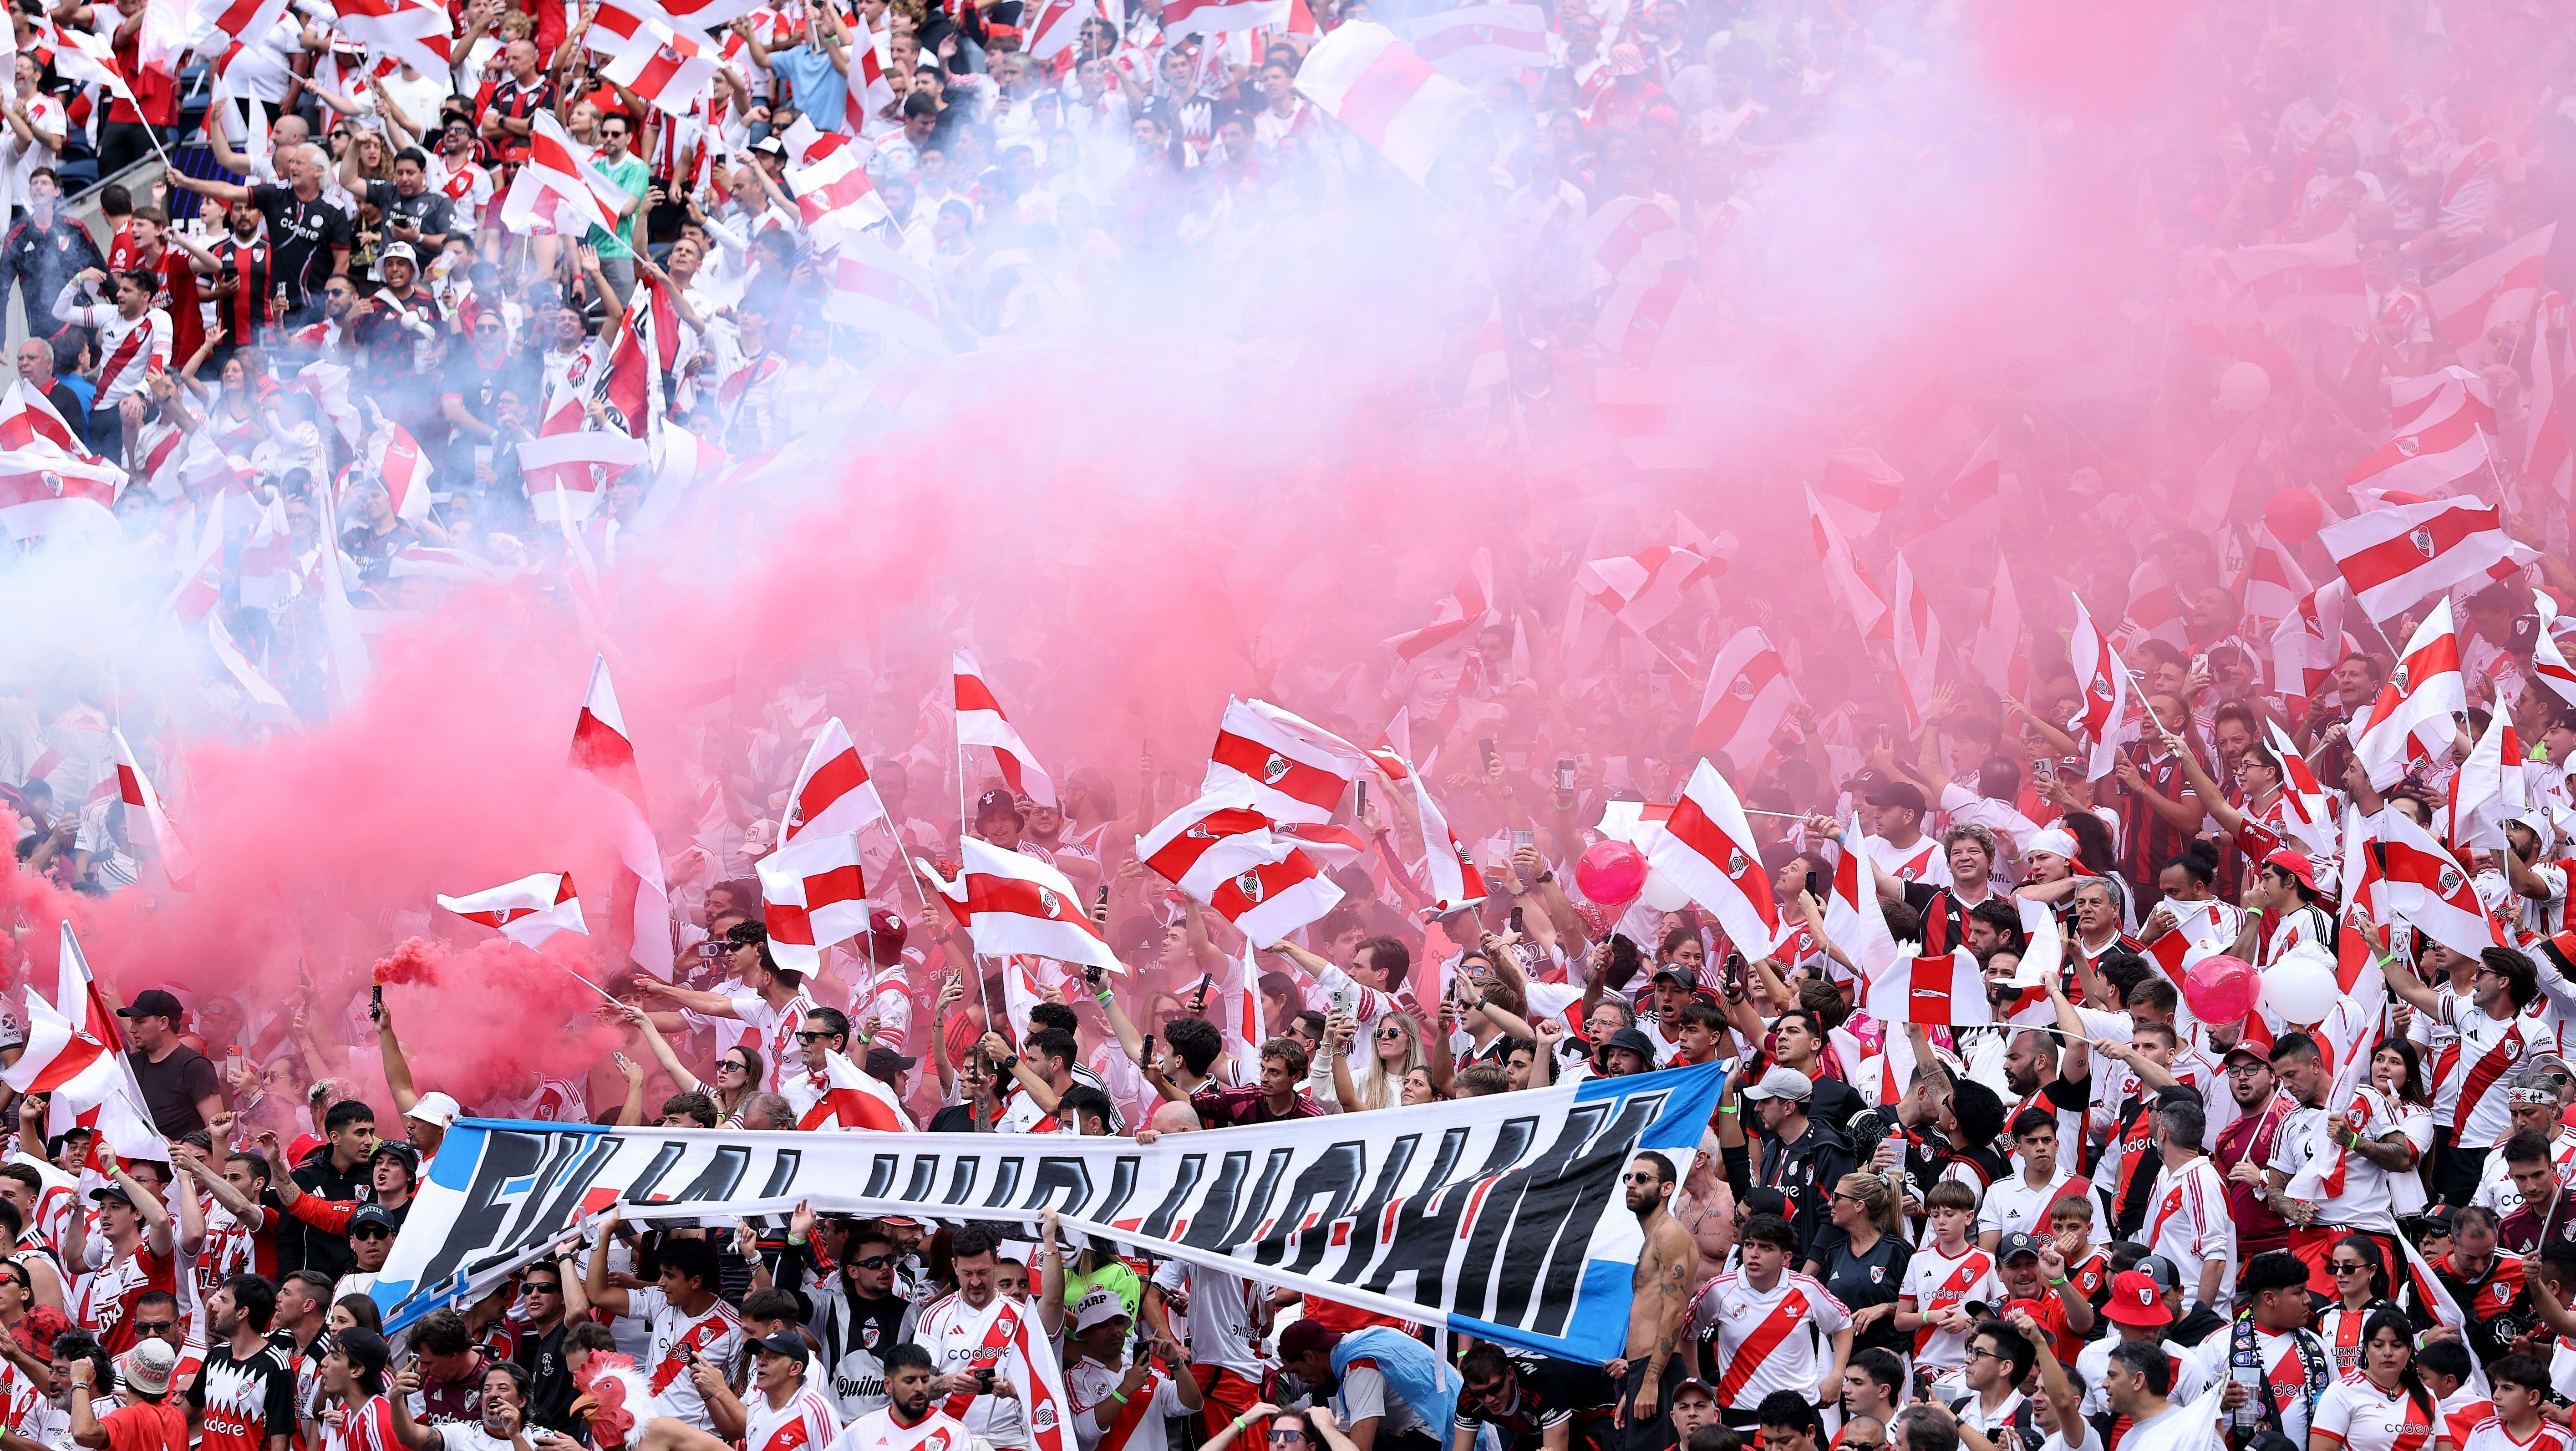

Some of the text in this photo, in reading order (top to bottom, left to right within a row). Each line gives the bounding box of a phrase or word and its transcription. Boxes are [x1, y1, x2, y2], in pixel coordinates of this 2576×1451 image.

[2443, 873, 2459, 889] CARP
[2532, 1037, 2551, 1047] ASSIST
[2121, 1136, 2157, 1155] odere
[356, 1206, 384, 1219] SEATTLE
[859, 1090, 1676, 1337] NGHAM
[2012, 1233, 2028, 1247] CARP
[1078, 1294, 1107, 1314] CARP
[1233, 1324, 1258, 1340] DIREC
[659, 1338, 689, 1363] code
[948, 1344, 1011, 1360] codere
[2331, 1346, 2361, 1357] URKIS
[2338, 1356, 2360, 1368] RLIN
[836, 1375, 887, 1401] Quilm
[204, 1415, 245, 1437] cdere
[428, 1411, 472, 1426] code
[2385, 1420, 2434, 1436] codere
